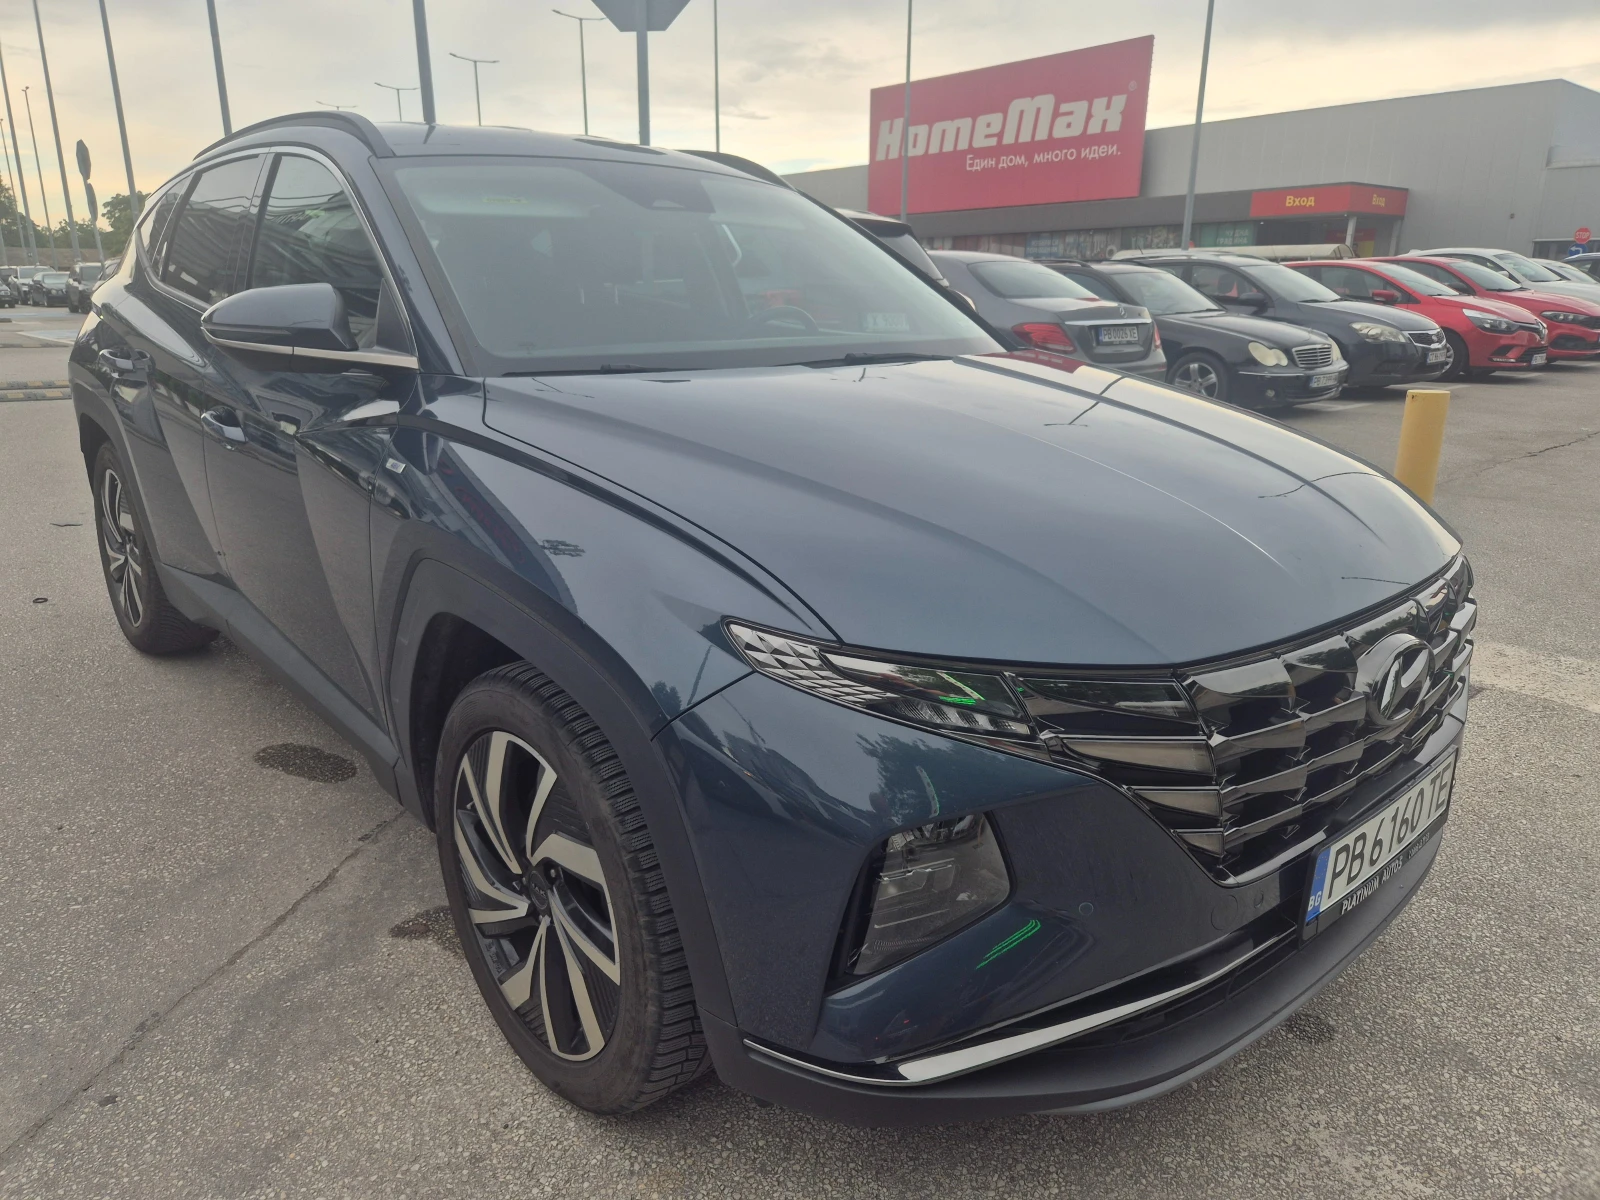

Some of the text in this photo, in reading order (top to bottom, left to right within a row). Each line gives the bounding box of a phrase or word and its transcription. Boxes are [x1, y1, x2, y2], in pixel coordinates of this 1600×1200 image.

[875, 93, 1128, 162] HomeMax
[966, 143, 1122, 172] Един дом, много идеи.
[1285, 195, 1315, 207] Вход
[1371, 194, 1386, 207] Вход
[1575, 231, 1590, 239] STOP
[1328, 831, 1367, 900] PB
[1369, 787, 1425, 867] 6160
[1427, 760, 1452, 820] TE
[1341, 855, 1404, 915] PLATINUM AUTOS
[1308, 890, 1322, 912] BG
